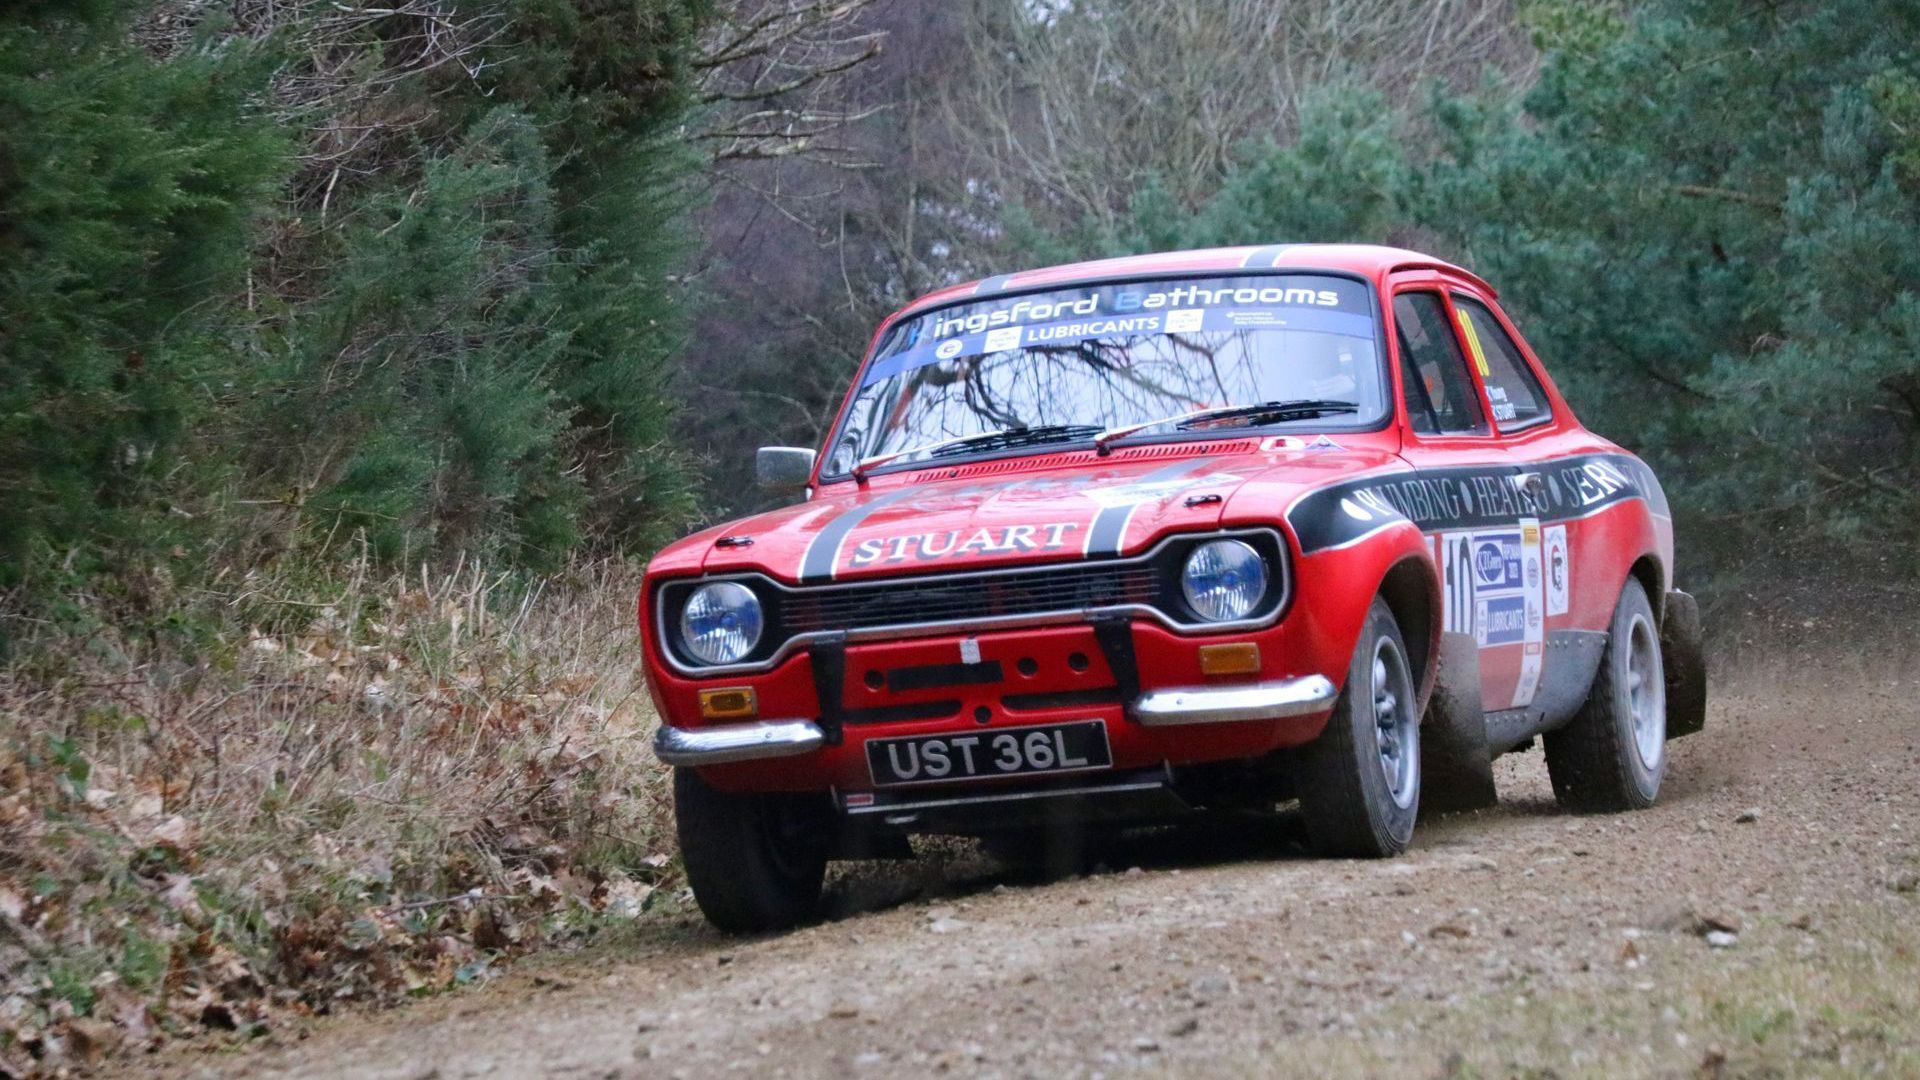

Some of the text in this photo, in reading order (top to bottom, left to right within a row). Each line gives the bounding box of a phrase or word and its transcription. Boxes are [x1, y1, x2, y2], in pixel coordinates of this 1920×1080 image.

[908, 294, 1099, 346] ingsford
[1114, 286, 1339, 311] Bathrooms
[1027, 317, 1160, 341] LUBRICANTS
[1470, 475, 1550, 517] HEATG
[852, 521, 1078, 566] STUART
[1446, 536, 1474, 633] 10
[1488, 608, 1523, 633] LUBRICANTS
[888, 730, 1088, 780] UST 36L
